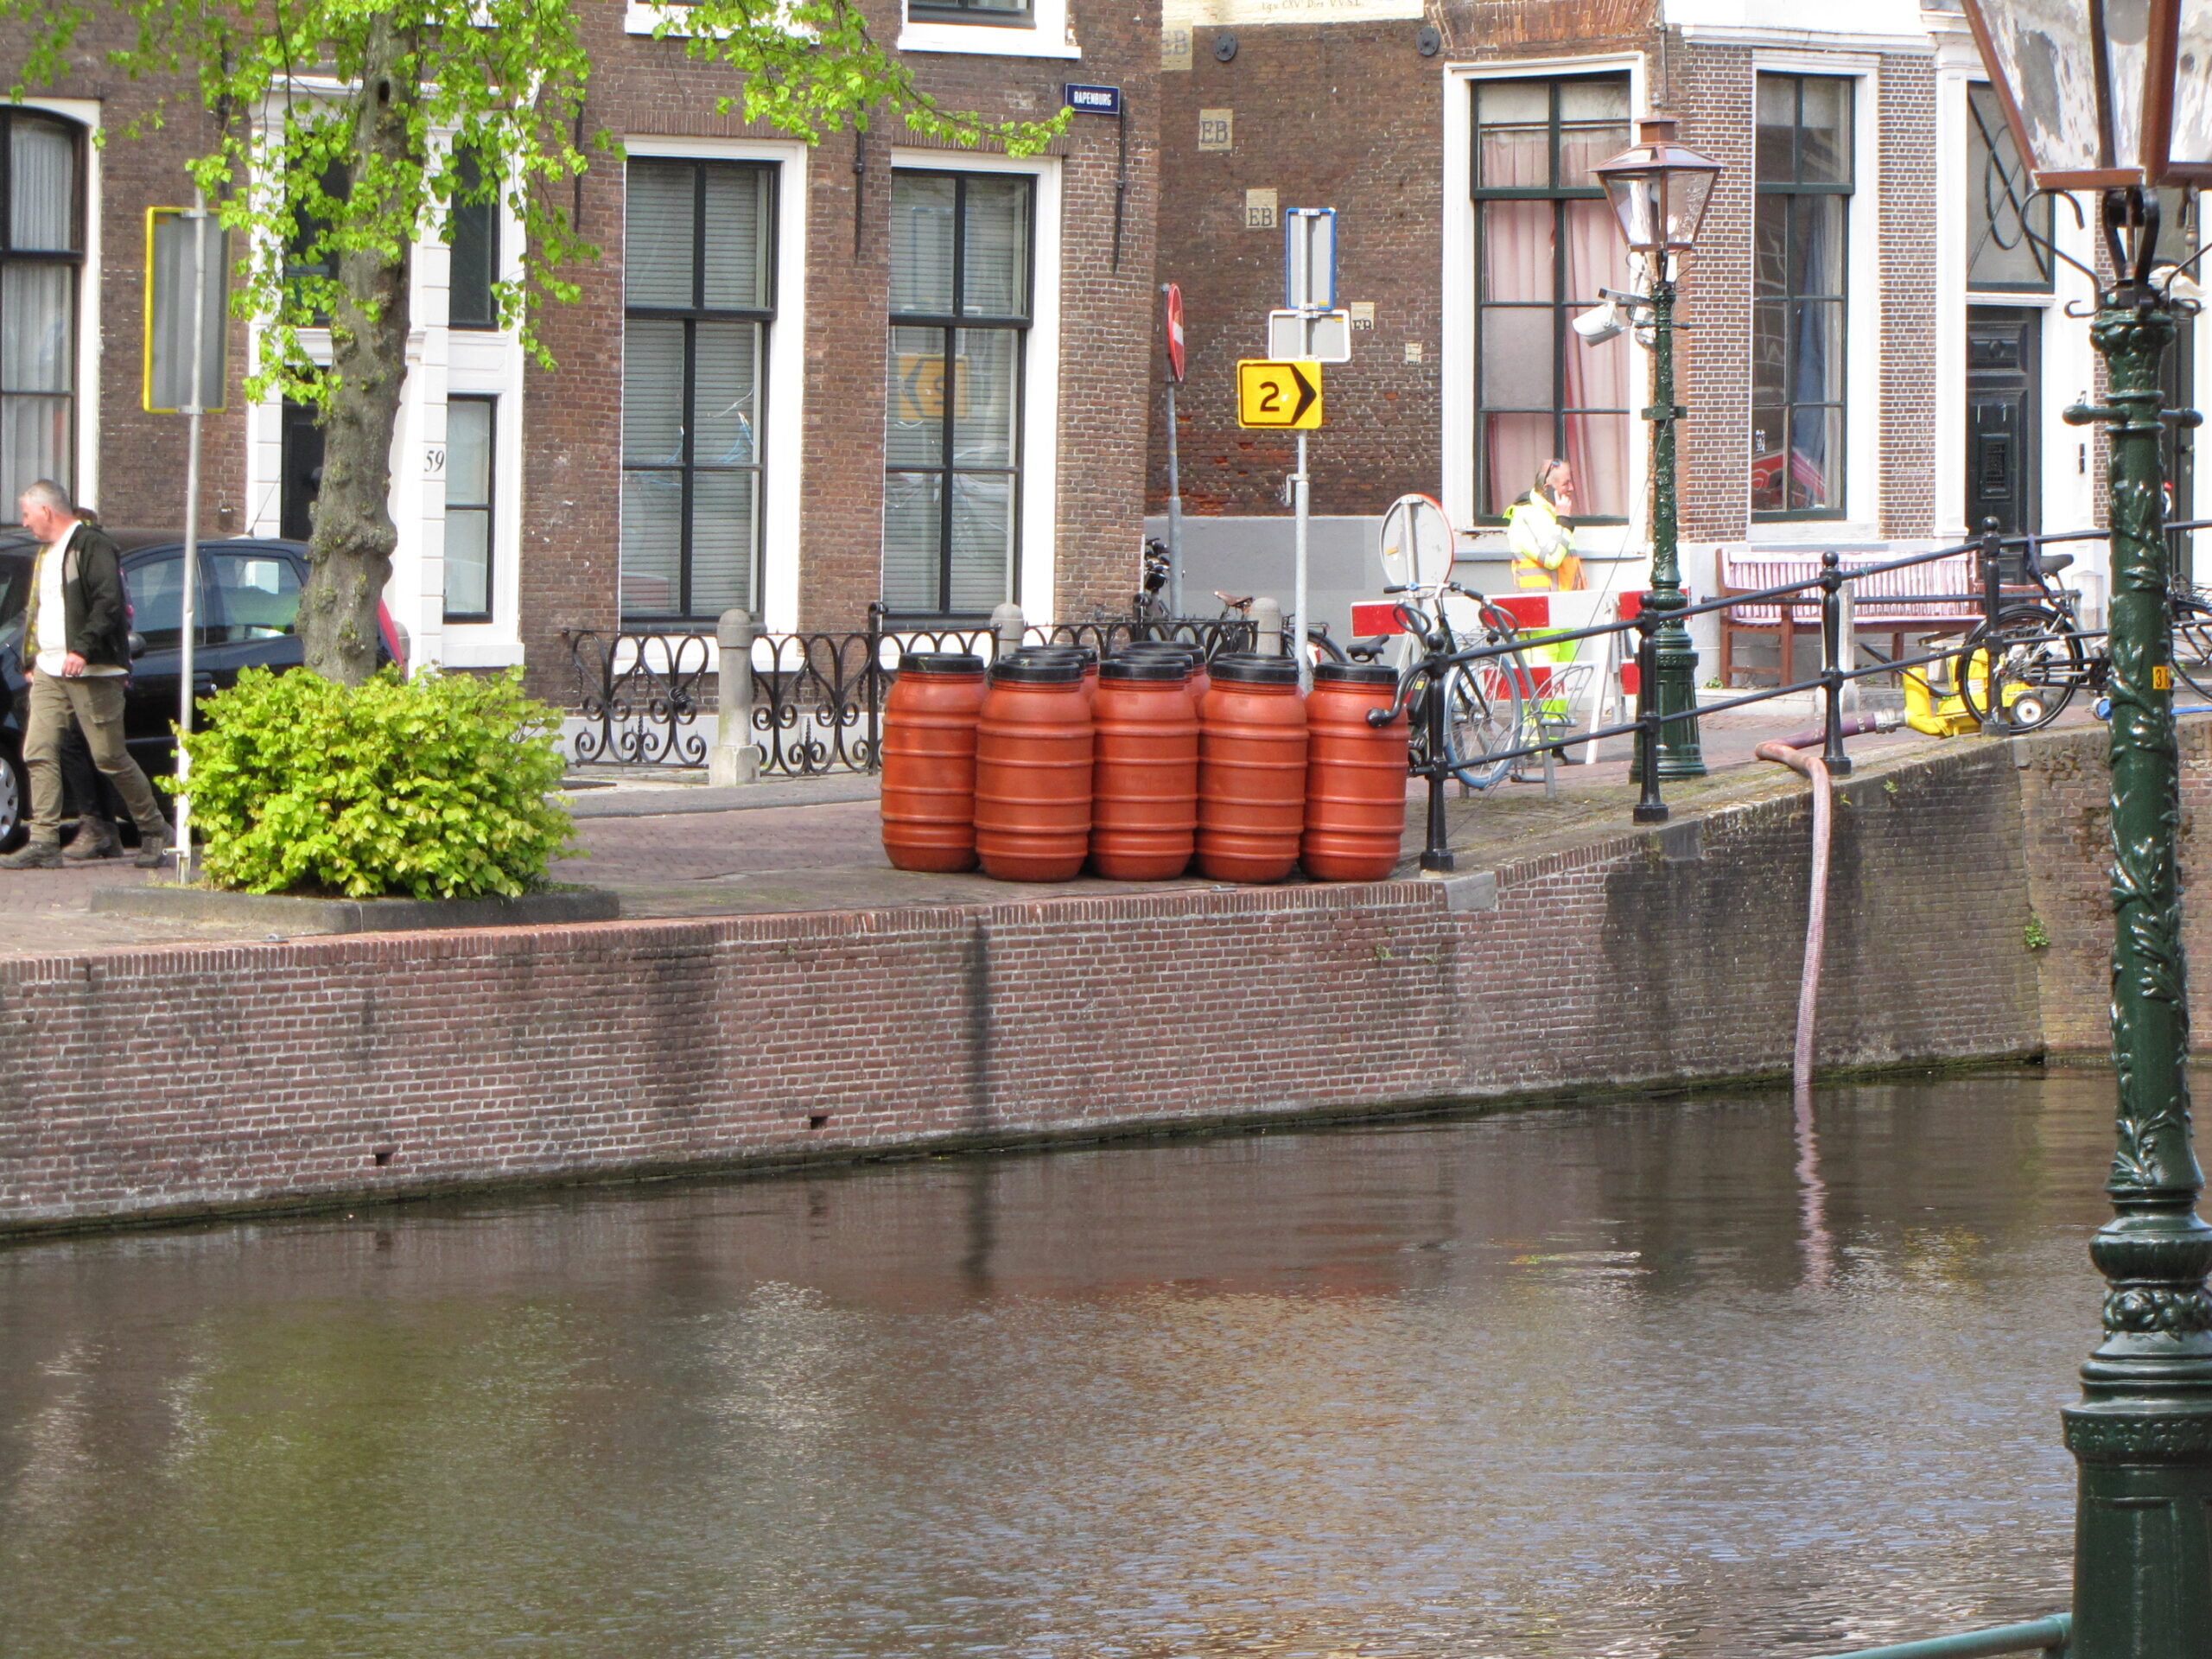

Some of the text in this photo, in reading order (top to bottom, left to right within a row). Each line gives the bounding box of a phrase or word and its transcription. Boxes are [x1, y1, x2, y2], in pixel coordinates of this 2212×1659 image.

[1074, 91, 1112, 106] RAPENBURG
[1201, 120, 1228, 144] EB
[1248, 207, 1272, 226] EB
[1259, 381, 1281, 412] 2
[423, 450, 445, 473] 59
